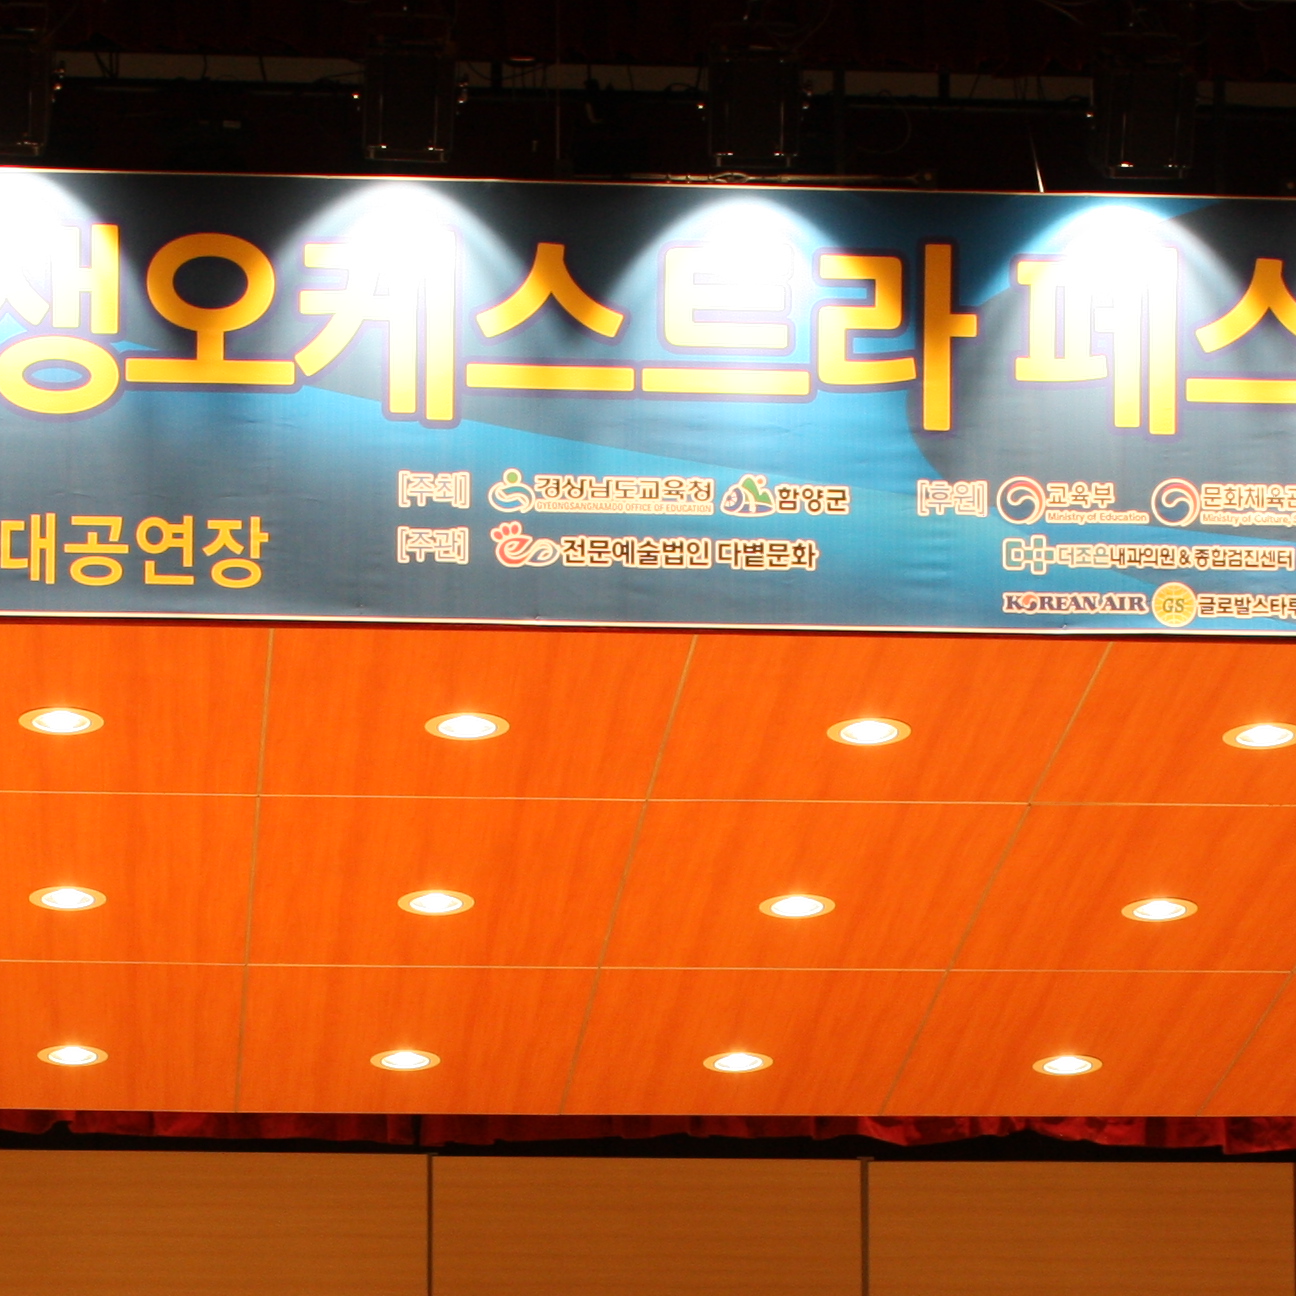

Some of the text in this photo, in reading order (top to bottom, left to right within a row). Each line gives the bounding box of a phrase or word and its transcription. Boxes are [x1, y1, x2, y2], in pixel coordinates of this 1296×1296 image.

[536, 476, 713, 502] 경상남도교육청
[777, 486, 848, 513] 함양군
[917, 479, 988, 517] [후원]
[1046, 484, 1115, 507] 교육부
[1047, 511, 1147, 523] Ministry of Education
[1203, 512, 1240, 525] Ministry
[1241, 514, 1252, 524] of
[562, 537, 818, 569] 전문예술법인 다볕문화
[1057, 545, 1293, 569] 더조은내과의원 & 종합검진센터
[1005, 592, 1147, 613] KOREAN AIR
[1162, 598, 1185, 613] GS
